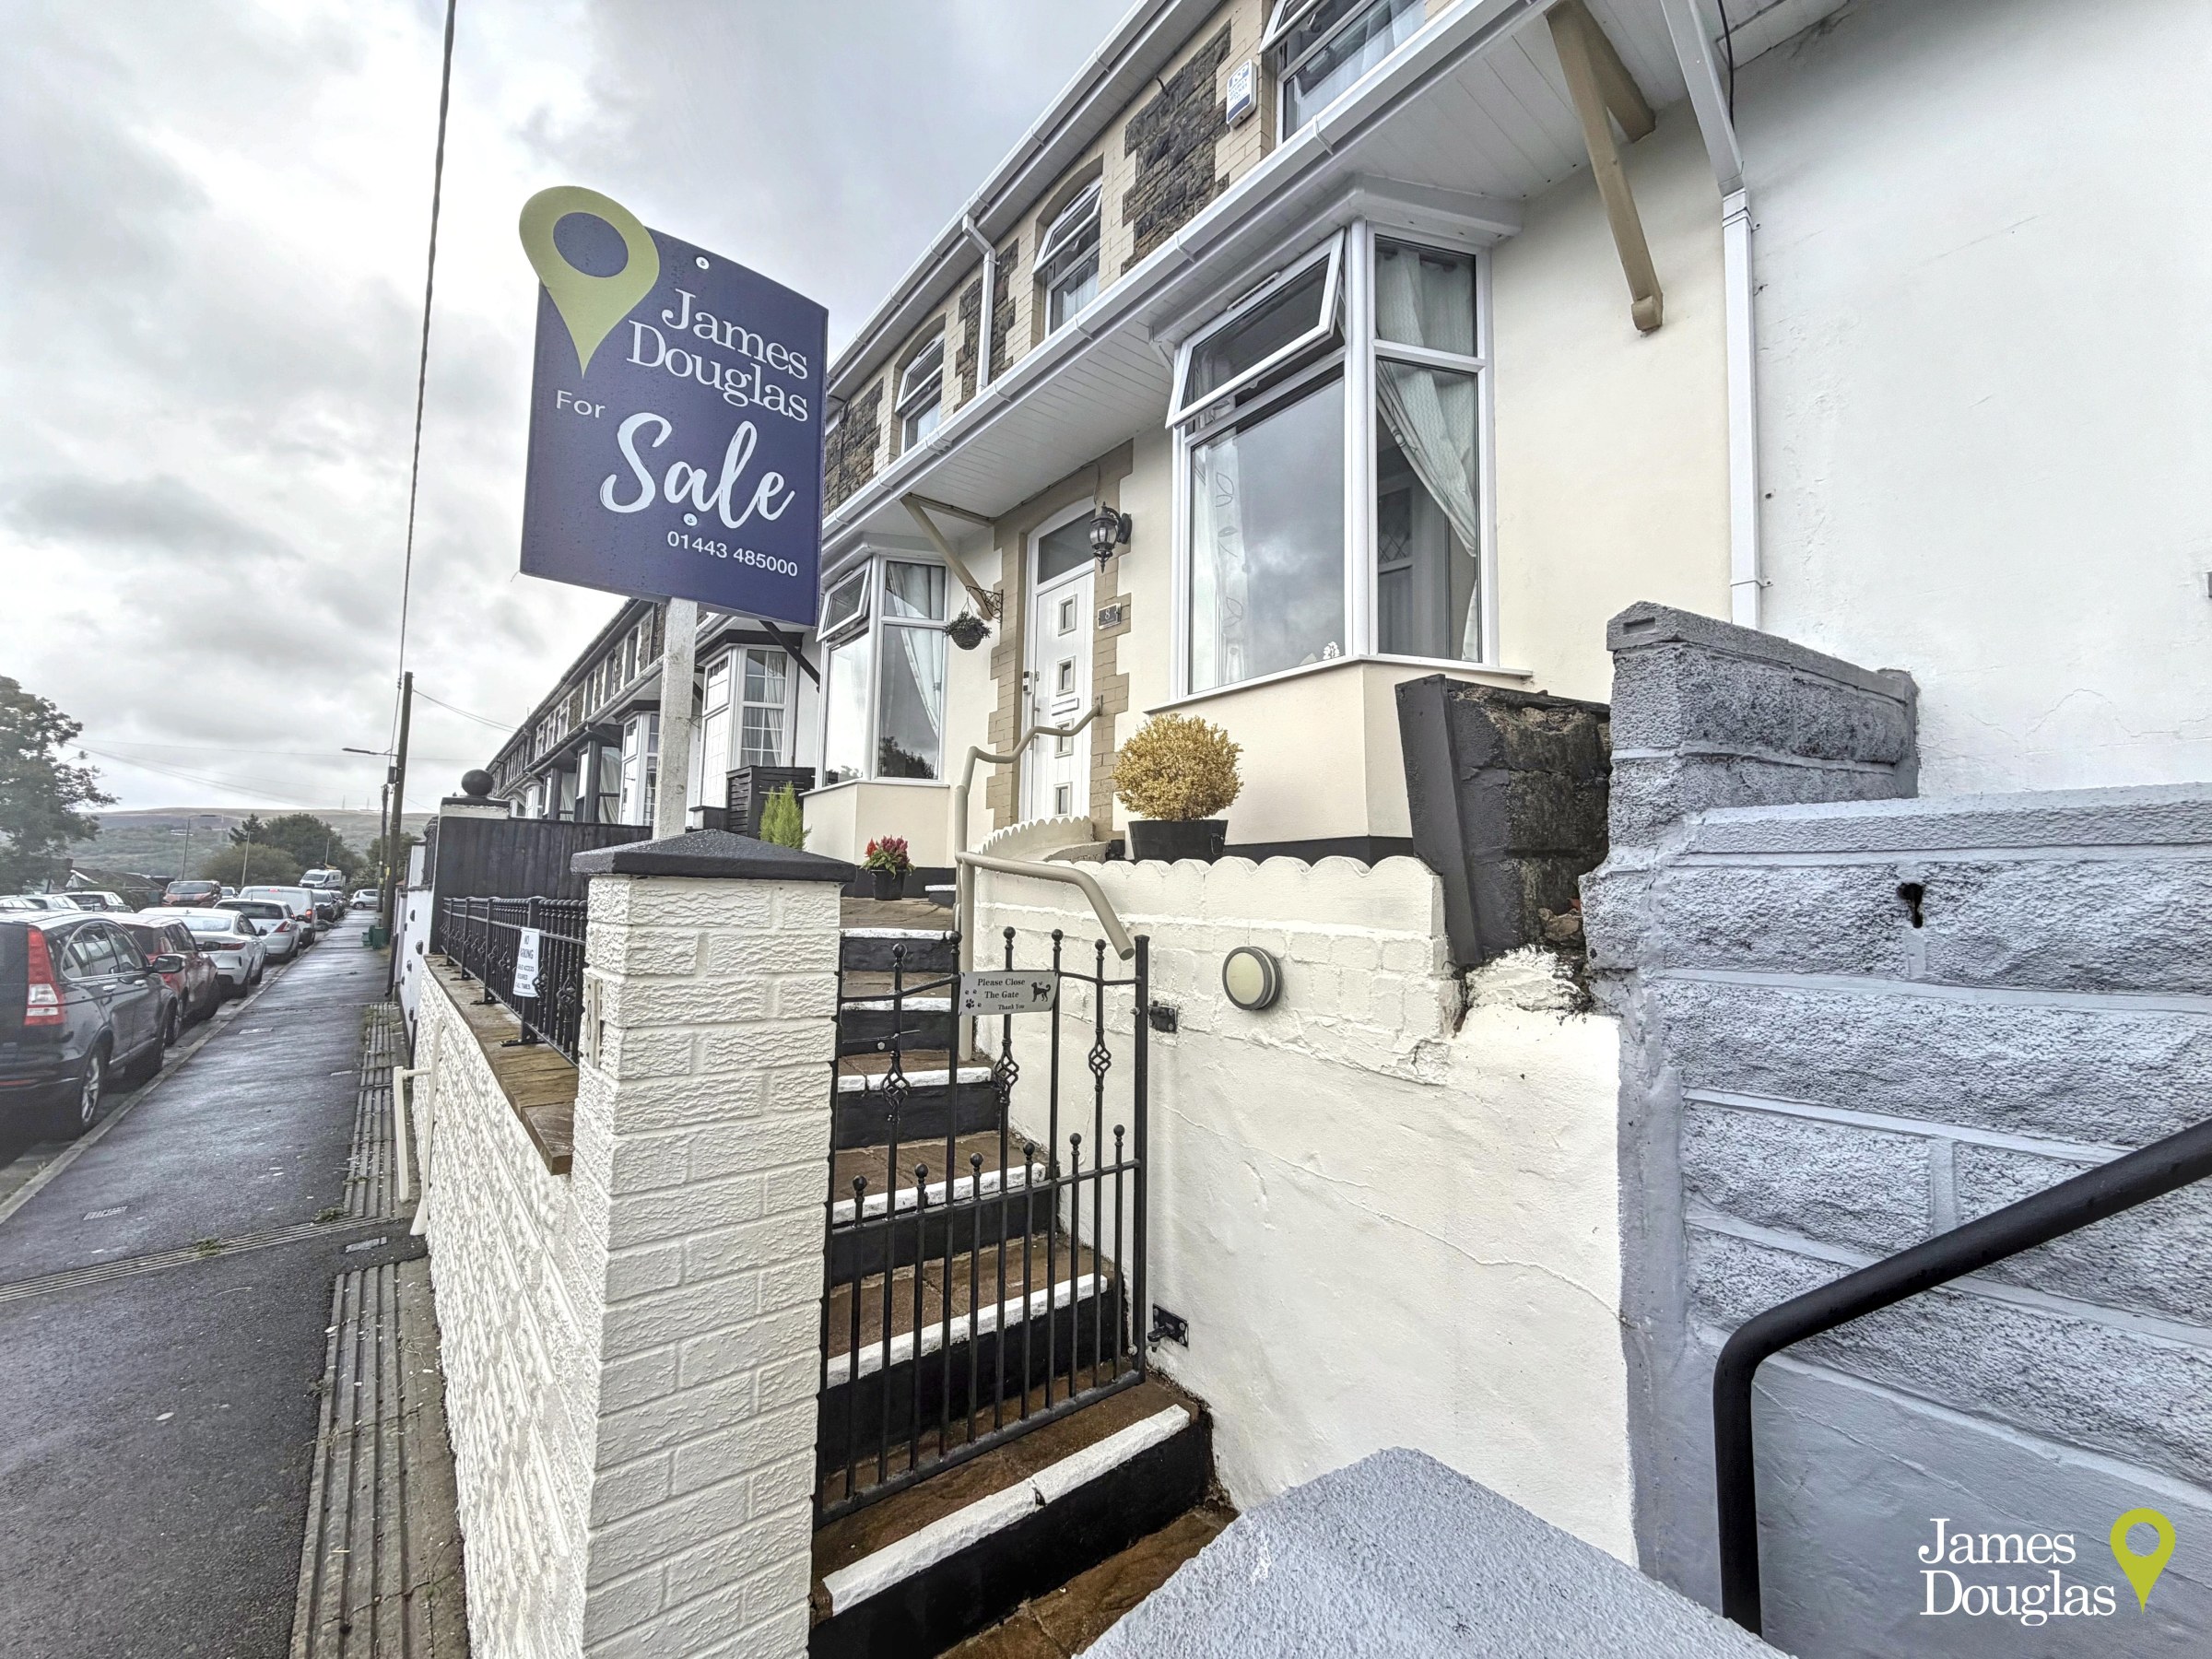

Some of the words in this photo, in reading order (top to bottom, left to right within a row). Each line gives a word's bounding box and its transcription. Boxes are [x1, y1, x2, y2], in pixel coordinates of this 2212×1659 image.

[661, 288, 808, 380] James
[556, 389, 606, 418] For
[626, 320, 808, 422] Douglas
[600, 411, 795, 530] Sale
[666, 530, 728, 559] 01443
[733, 544, 799, 578] 485000
[977, 978, 1003, 986] Please
[1005, 978, 1026, 986] Close
